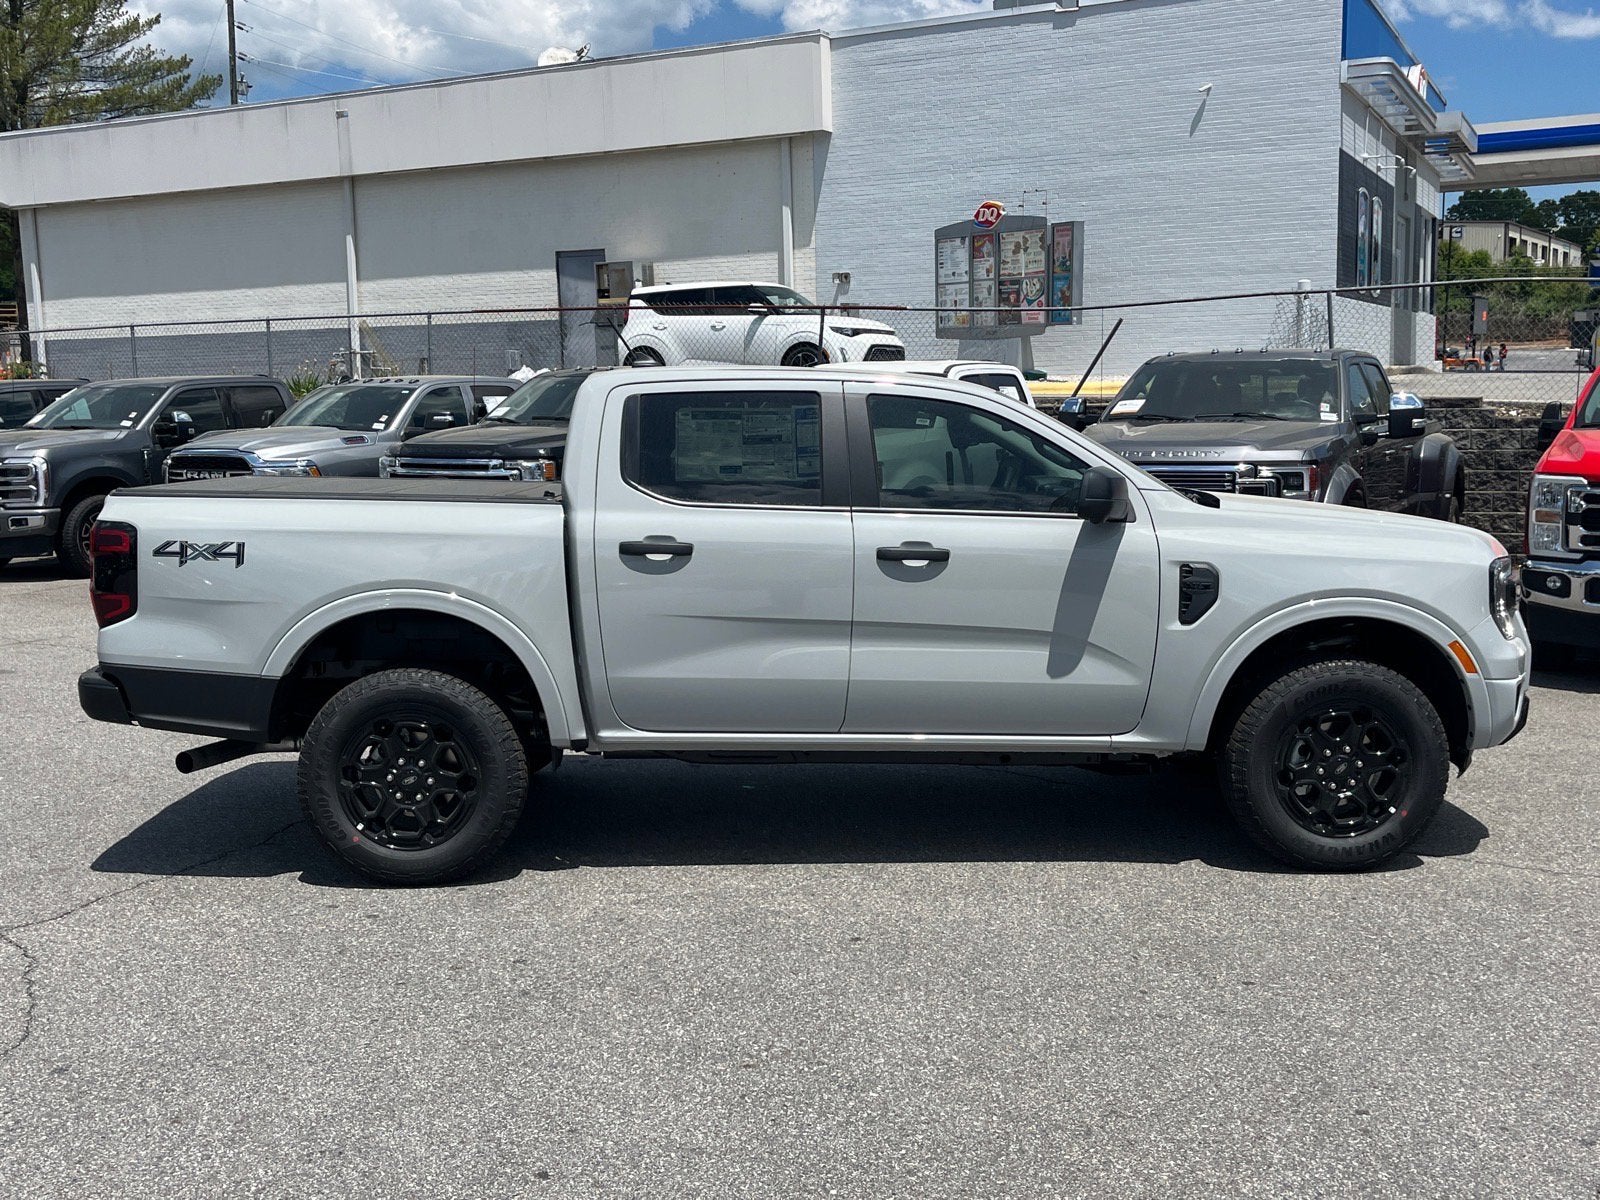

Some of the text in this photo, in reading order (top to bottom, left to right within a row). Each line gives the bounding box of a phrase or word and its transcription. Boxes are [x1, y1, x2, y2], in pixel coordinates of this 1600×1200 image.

[977, 207, 998, 222] DQ
[1117, 449, 1166, 458] PER
[186, 470, 224, 479] RAM
